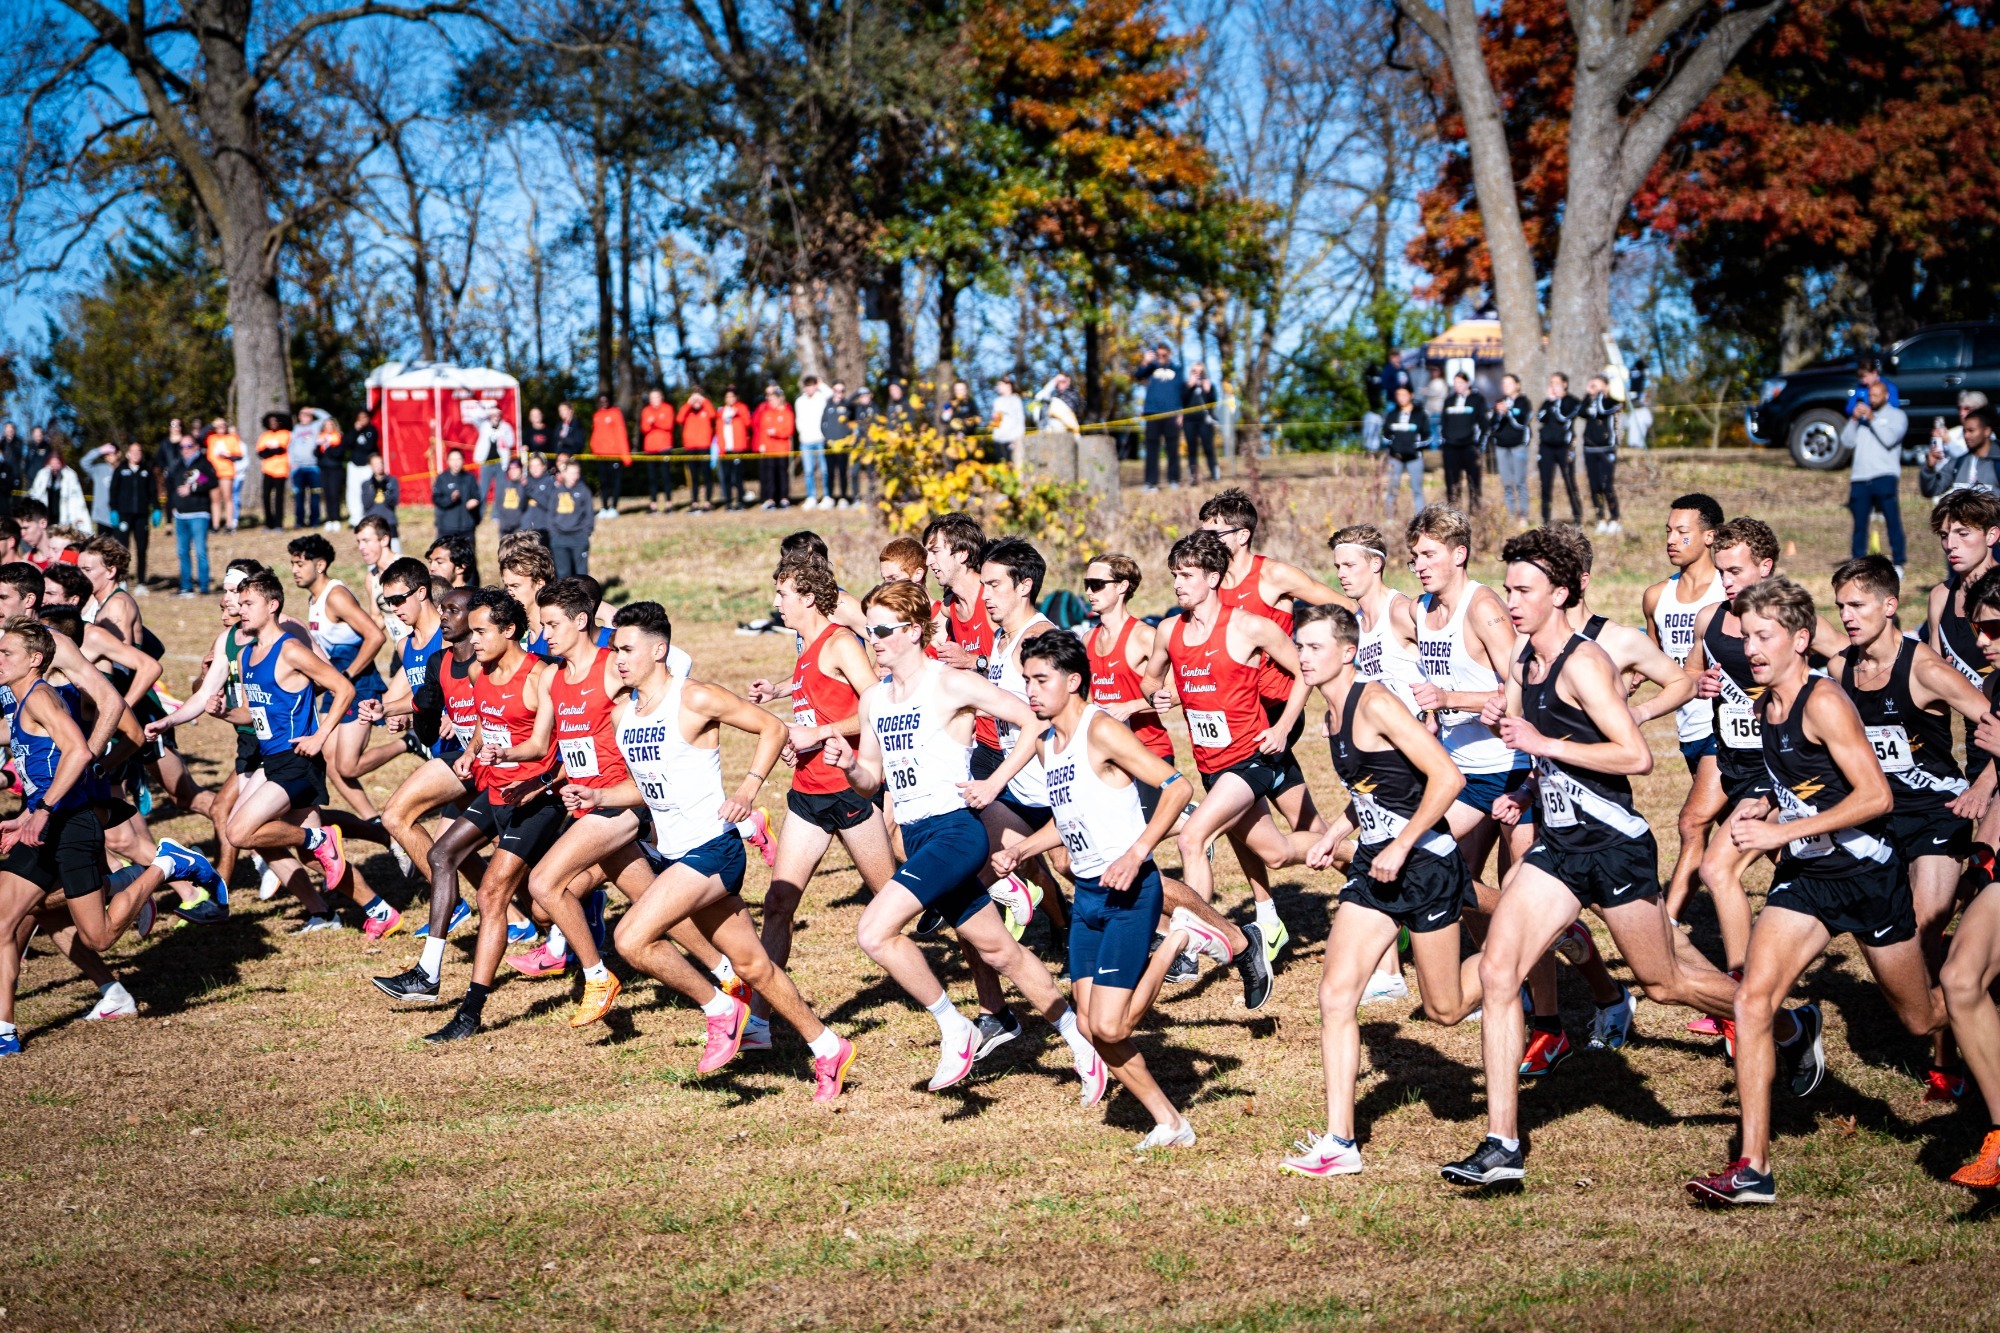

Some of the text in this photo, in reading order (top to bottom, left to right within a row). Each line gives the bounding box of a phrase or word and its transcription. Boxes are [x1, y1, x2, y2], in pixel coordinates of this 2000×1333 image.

[1665, 614, 1695, 628] ROGE
[1358, 641, 1383, 663] ROGERS
[1419, 641, 1452, 658] ROGERS
[406, 665, 427, 676] NEBRAS
[1181, 663, 1211, 677] Central
[1424, 660, 1450, 675] STATE
[1092, 672, 1115, 685] Central
[1094, 690, 1122, 701] Missouri
[1183, 682, 1217, 693] Missouri
[448, 696, 475, 709] Central
[481, 701, 506, 717] Central
[558, 701, 587, 716] Central
[452, 712, 478, 724] Missour
[482, 717, 509, 732] Missouri
[560, 720, 591, 733] Missouri
[877, 713, 921, 734] ROGERS
[623, 726, 666, 746] ROGERS
[1197, 721, 1219, 738] 118
[1731, 718, 1761, 737] 156
[883, 733, 914, 751] STATE
[1874, 740, 1899, 760] 54
[567, 750, 587, 768] 110
[628, 745, 661, 763] STATE
[892, 767, 917, 789] 286
[1046, 764, 1076, 788] ROGERS
[641, 781, 665, 799] 287
[1049, 786, 1073, 807] STATE
[1358, 809, 1376, 831] 59
[1065, 831, 1089, 853] 291
